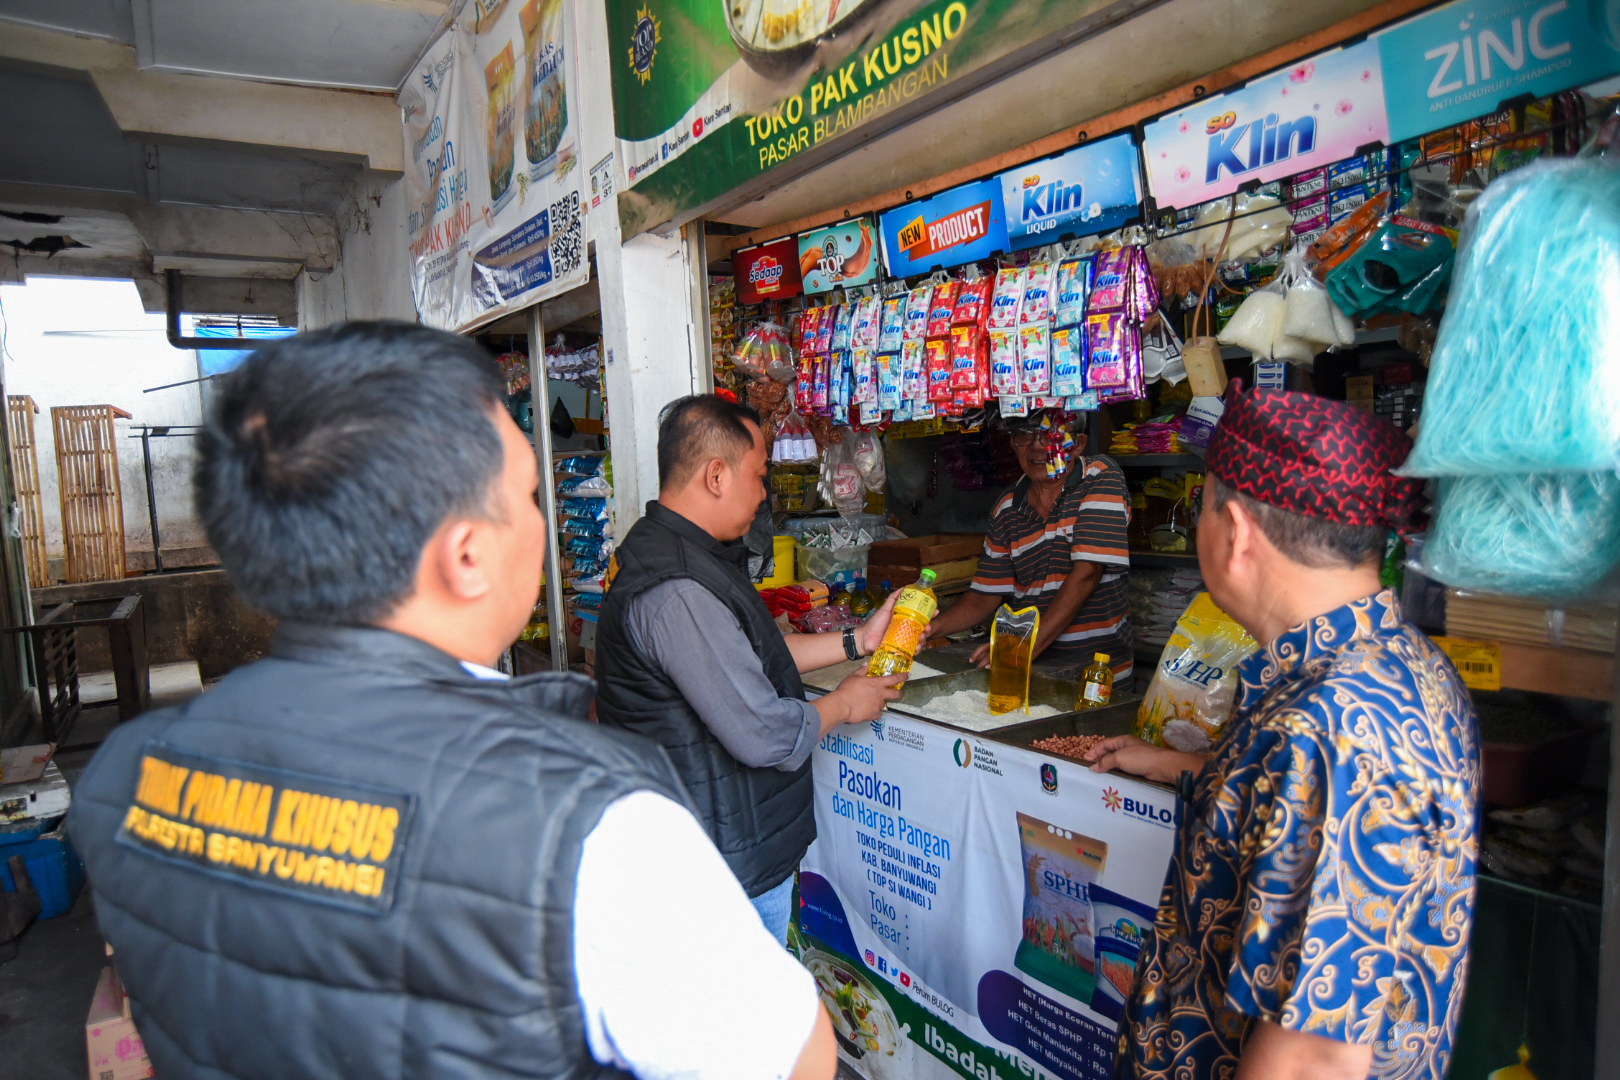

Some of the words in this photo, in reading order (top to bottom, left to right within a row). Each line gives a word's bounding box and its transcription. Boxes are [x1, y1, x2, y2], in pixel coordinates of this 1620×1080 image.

[745, 95, 803, 146] TOKO
[811, 62, 858, 115] PAK
[863, 1, 967, 87] KUSNO
[1430, 98, 1453, 113] ANTI
[1455, 77, 1512, 104] DANDRUFF
[1514, 59, 1572, 83] SHAMPOO
[759, 126, 810, 170] PASAR
[814, 53, 948, 144] BLAMBANGAN
[1206, 111, 1237, 135] SO
[1205, 113, 1317, 185] Klin
[1023, 175, 1040, 189] SO
[1022, 179, 1084, 224] Klin
[900, 224, 922, 248] NEW
[928, 207, 984, 251] PRODUCT
[1026, 219, 1057, 235] LIQUID
[749, 264, 783, 283] Sedaap
[817, 254, 845, 276] TOP
[1096, 274, 1121, 288] Klin
[957, 293, 979, 305] Klin
[994, 296, 1016, 307] Klin
[1025, 288, 1047, 300] Klin
[1059, 291, 1079, 304] Klin
[908, 310, 925, 320] Klin
[931, 309, 951, 319] Klin
[884, 325, 900, 334] Klin
[954, 357, 973, 369] Klin
[993, 363, 1012, 374] Klin
[1024, 359, 1045, 371] Klin
[1092, 351, 1119, 365] Klin
[931, 371, 950, 381] Klin
[1055, 363, 1077, 376] Klin
[889, 726, 925, 740] KEMENTERIAN
[889, 732, 925, 747] PERDAGANGAN
[974, 746, 993, 757] BADAN
[974, 754, 997, 767] PANGAN
[974, 762, 1003, 776] NASIONAL
[839, 760, 901, 811] Pasokan
[1123, 797, 1178, 826] BULO
[271, 789, 399, 862] KHUSUS
[832, 791, 854, 820] dan
[857, 800, 894, 838] Harga
[898, 816, 950, 861] Pangan
[206, 833, 385, 897] BANYUWANGI
[856, 831, 876, 850] TOKO
[878, 841, 905, 864] PEDULI
[908, 853, 941, 879] INFLASI
[1083, 851, 1102, 862] BULOG
[861, 850, 879, 868] KAB.
[881, 859, 937, 895] BANYUWANGI
[873, 871, 886, 888] TOP
[889, 880, 896, 894] SI
[898, 883, 926, 907] WANGI
[807, 903, 843, 924] www.bulog.co.id
[869, 890, 896, 921] Toko
[871, 913, 901, 945] Pasar
[912, 982, 931, 1002] Perum
[932, 993, 954, 1017] BULOG
[1023, 987, 1036, 1000] HET
[1038, 996, 1063, 1016] (Harga
[1066, 1012, 1094, 1032] Eceran
[1008, 1009, 1023, 1023] HET
[1025, 1020, 1041, 1036] Gula
[1043, 1032, 1082, 1061] ManisKita
[1019, 999, 1033, 1015] HET
[1035, 1011, 1057, 1030] Beras
[1059, 1025, 1082, 1043] SPHP
[1094, 1044, 1106, 1057] Rp
[1028, 1037, 1043, 1053] HET
[1045, 1048, 1083, 1079] Minyakita
